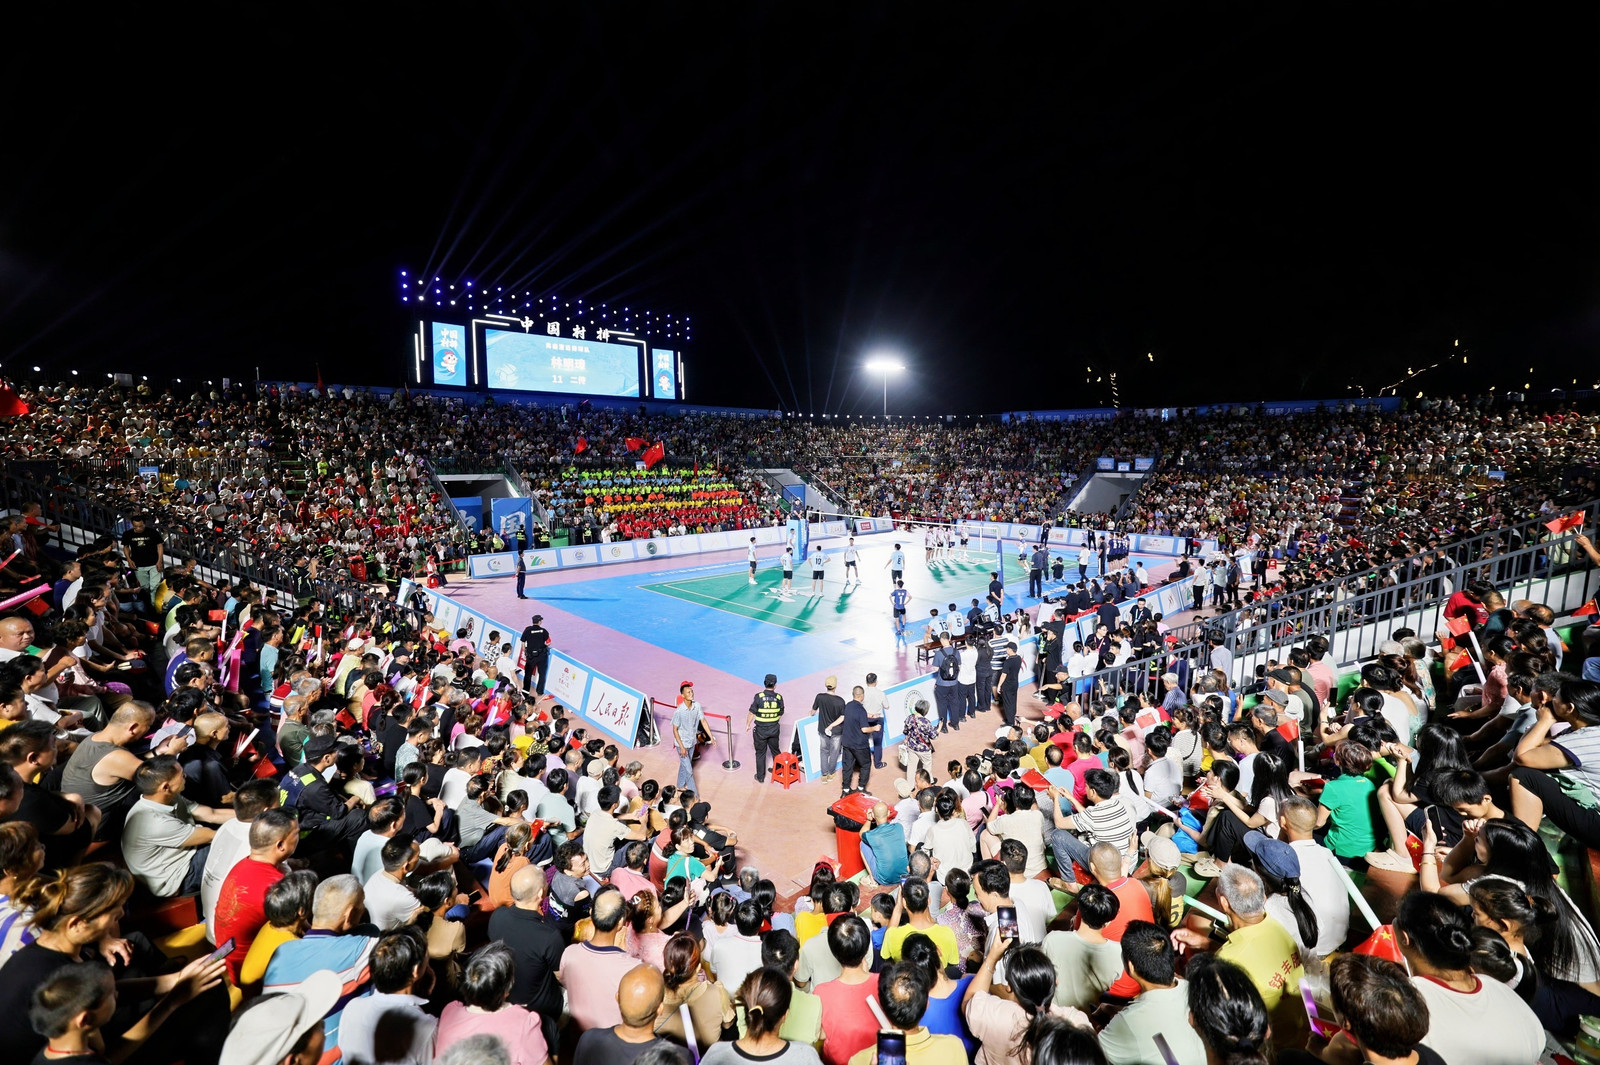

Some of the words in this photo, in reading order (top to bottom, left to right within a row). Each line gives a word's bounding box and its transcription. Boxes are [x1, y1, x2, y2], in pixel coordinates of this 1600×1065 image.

[440, 327, 459, 339] 中国
[520, 315, 611, 343] 中国村排
[939, 621, 949, 631] 13
[956, 618, 963, 628] 5
[591, 692, 631, 727] 人民日报
